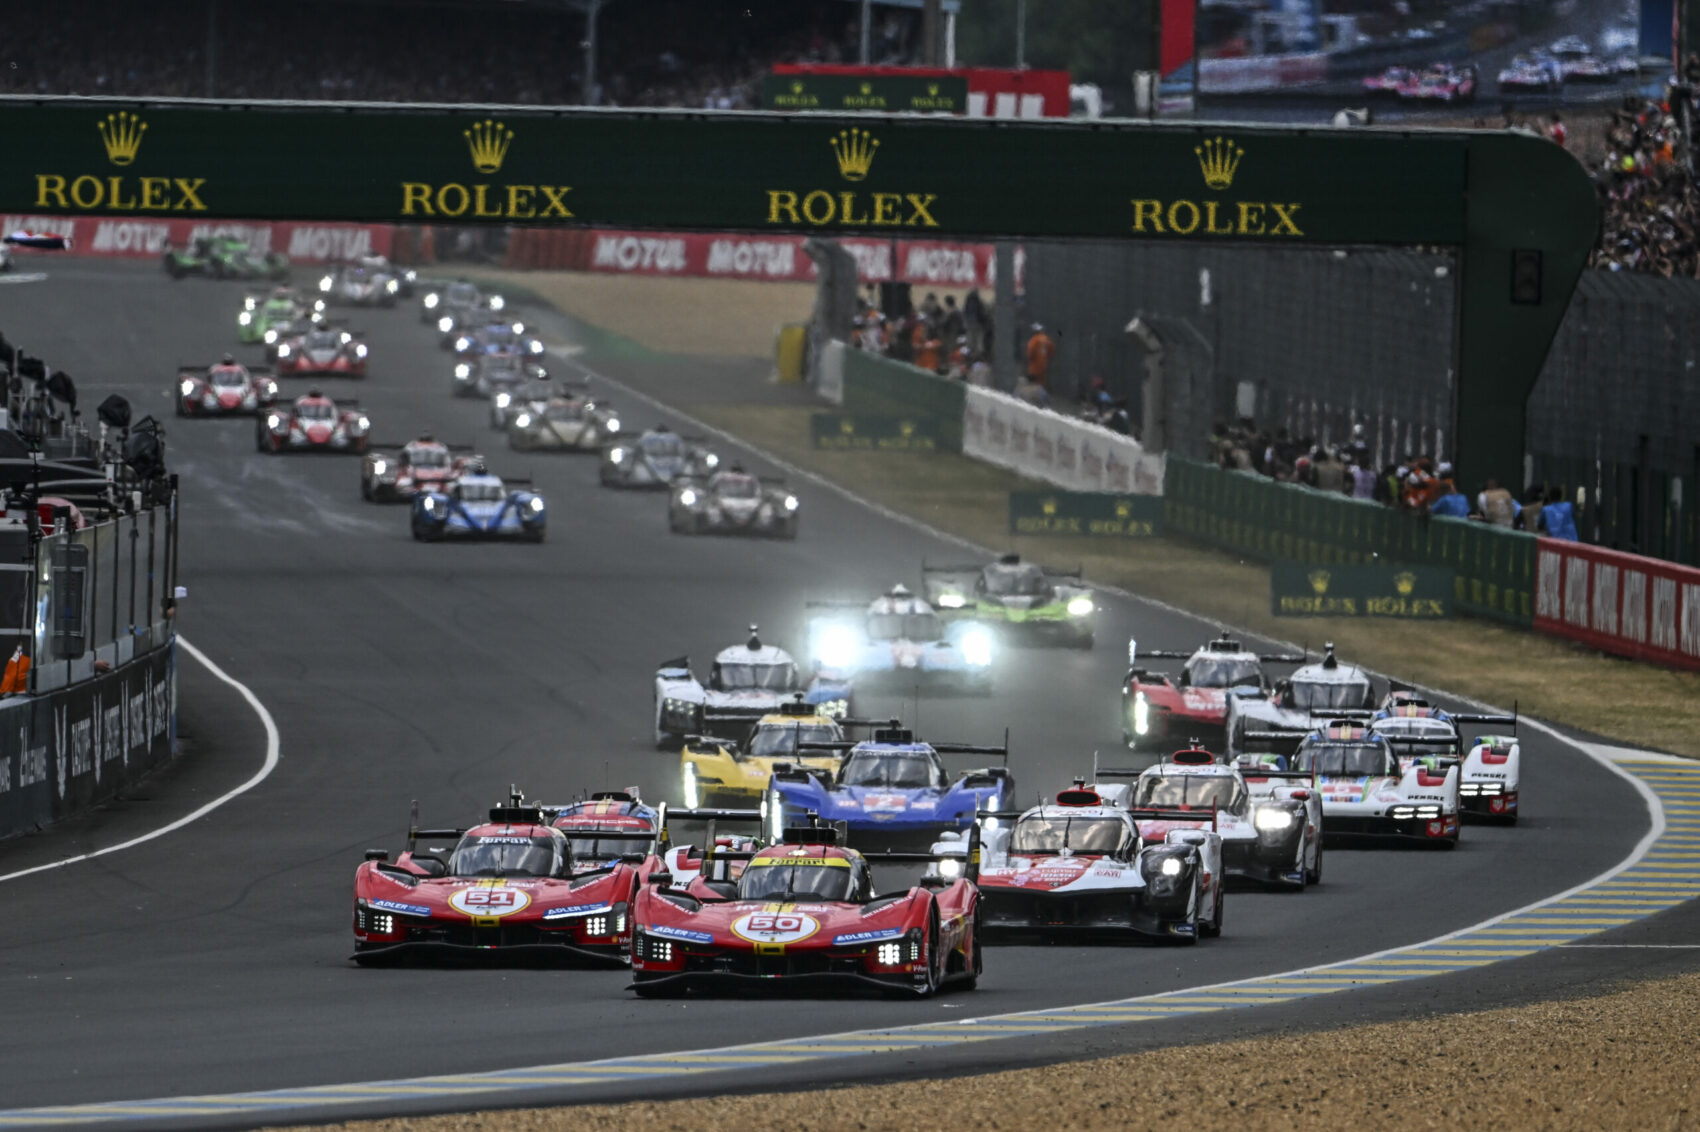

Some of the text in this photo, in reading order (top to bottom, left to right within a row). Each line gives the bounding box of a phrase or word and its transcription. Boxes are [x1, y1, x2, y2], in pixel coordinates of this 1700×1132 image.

[35, 175, 207, 211] ROLEX
[402, 183, 573, 218] ROLEX
[767, 190, 939, 226] ROLEX
[1132, 199, 1304, 235] ROLEX
[289, 226, 371, 259] MOTUL
[594, 236, 686, 270] MOTUL
[708, 239, 794, 275] MOTUL
[1367, 597, 1444, 616] ROLEX
[477, 837, 533, 845] Ferrari
[769, 858, 826, 866] Ferrari
[375, 900, 409, 911] ADLER
[468, 892, 512, 904] 51
[548, 905, 582, 915] ADLER
[654, 926, 689, 936] ADLER
[751, 917, 800, 930] 50
[837, 931, 872, 942] ADLER
